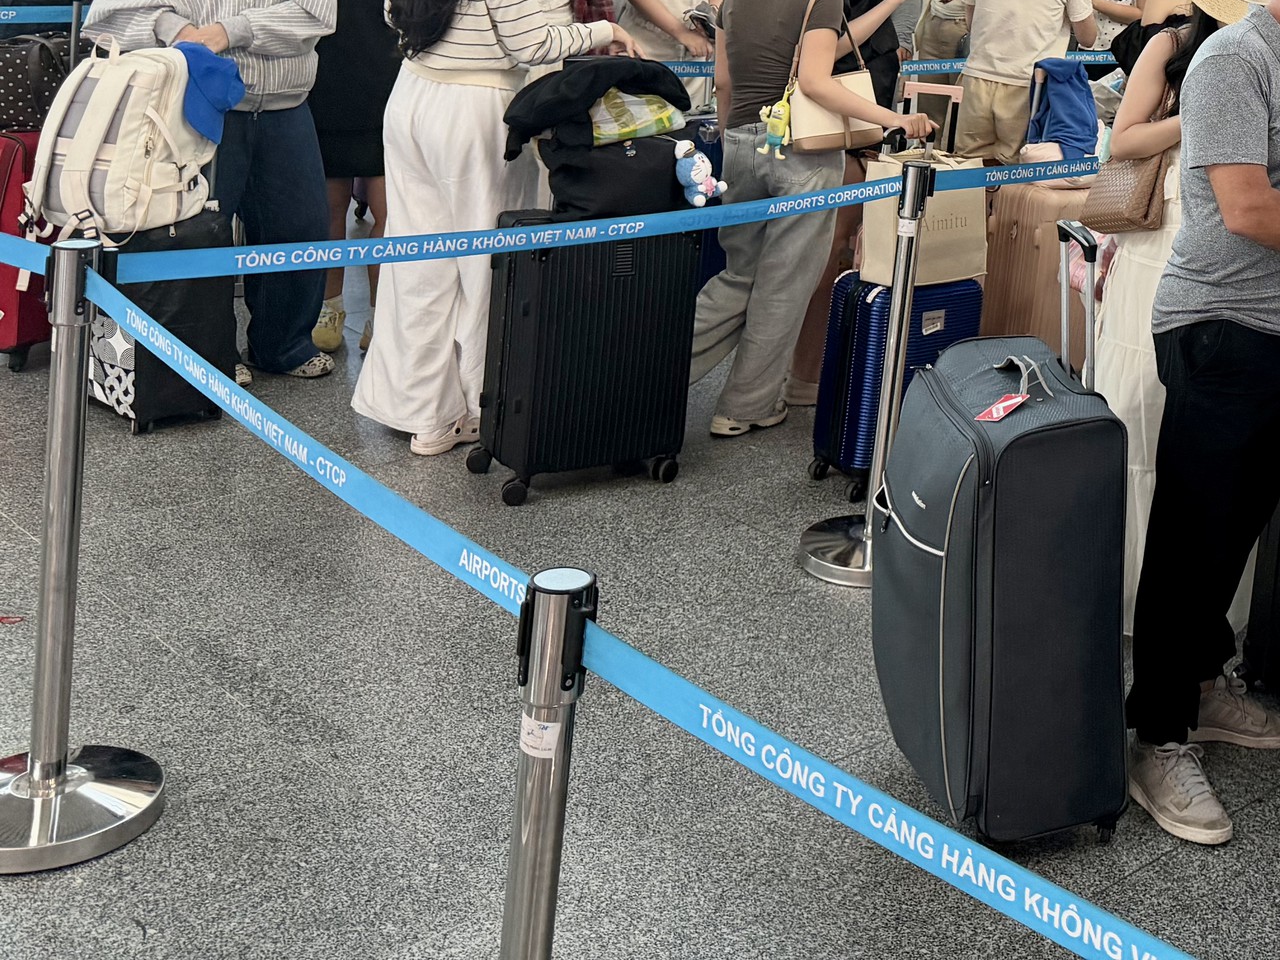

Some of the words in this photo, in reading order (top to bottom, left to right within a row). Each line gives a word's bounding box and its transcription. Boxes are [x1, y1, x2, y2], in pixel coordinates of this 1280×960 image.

[0, 10, 16, 20] CP
[941, 62, 951, 70] OF
[1010, 167, 1034, 179] CÔNG
[1036, 166, 1046, 176] TY
[767, 194, 825, 215] AIRPORTS
[827, 180, 902, 205] CORPORATION
[921, 213, 968, 233] Aimitu
[291, 246, 342, 263] CÔNG
[347, 246, 368, 259] TY
[423, 237, 468, 253] HÀNG
[472, 232, 527, 250] KHÔNG
[531, 229, 562, 245] VIỆT
[565, 226, 597, 241] NAM
[608, 221, 645, 236] CTCP
[149, 327, 172, 356] CÔNG
[173, 344, 183, 364] TY
[208, 372, 230, 405] HÀNG
[231, 393, 262, 431] KHÔNG
[264, 417, 284, 447] VIỆT
[284, 435, 308, 465] NAM
[316, 456, 347, 487] CTCP
[459, 548, 526, 606] AIRPORTS
[699, 703, 756, 758] TỔNG
[761, 744, 826, 798] CÔNG
[833, 781, 863, 816] TY
[868, 803, 935, 860] CẢNG
[941, 843, 1016, 902] HÀNG
[1024, 887, 1122, 960] KHÔNG
